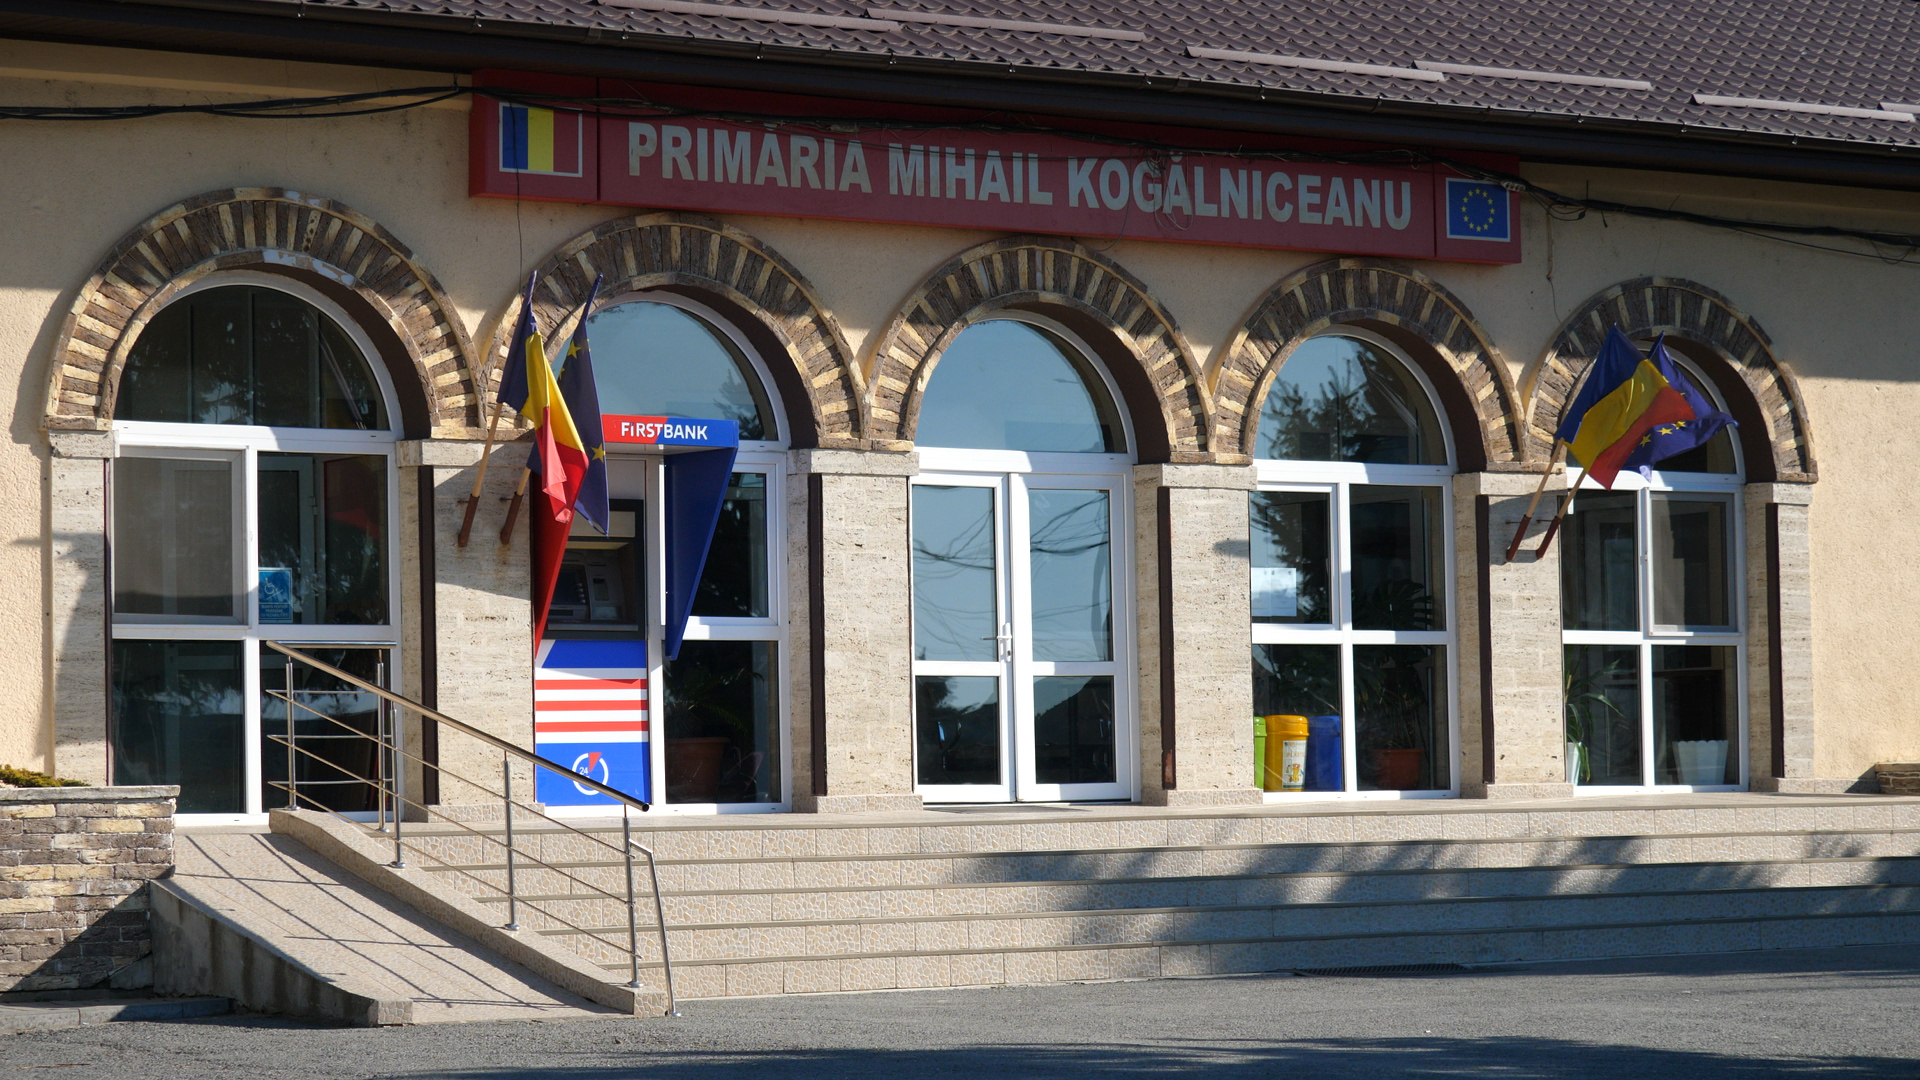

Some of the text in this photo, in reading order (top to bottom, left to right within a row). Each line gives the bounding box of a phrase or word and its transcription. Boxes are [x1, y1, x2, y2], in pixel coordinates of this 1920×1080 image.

[888, 143, 1053, 205] MIHAIL
[1067, 151, 1411, 231] KOGĂLNICEANU
[579, 767, 589, 775] 24
